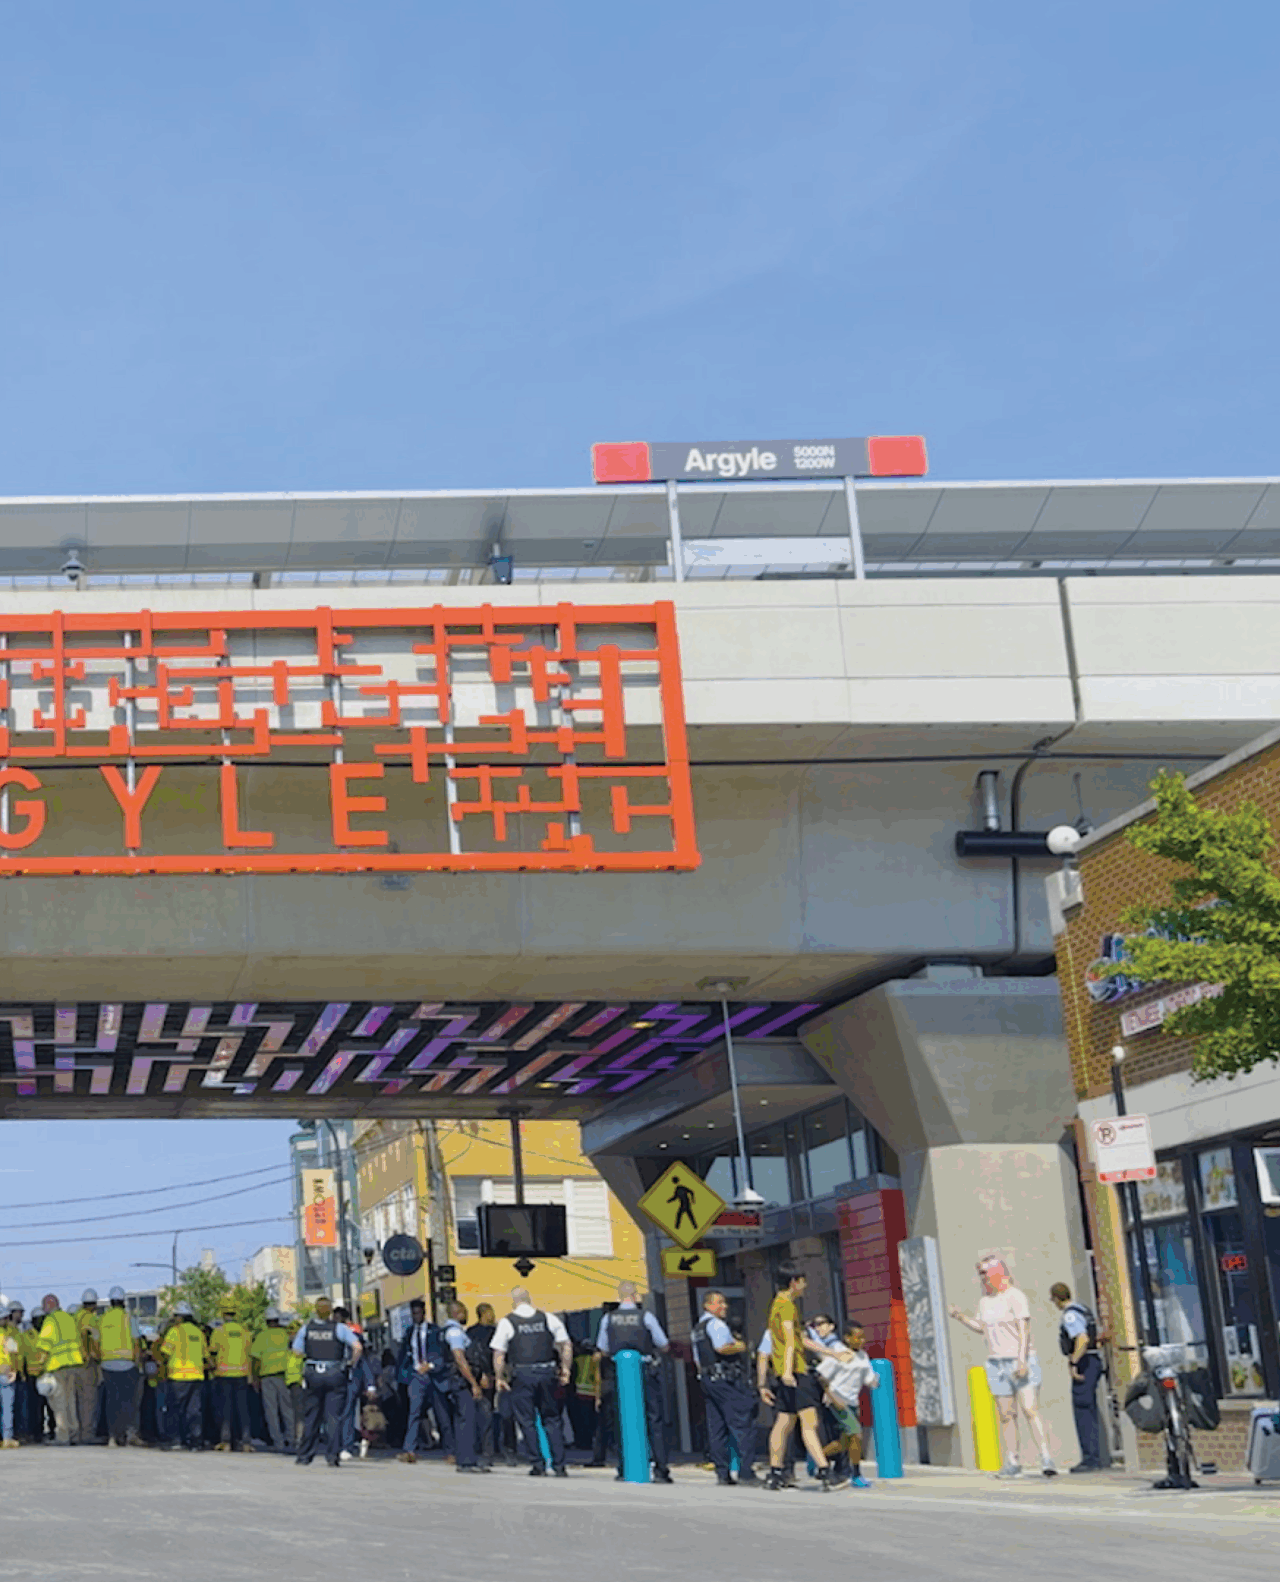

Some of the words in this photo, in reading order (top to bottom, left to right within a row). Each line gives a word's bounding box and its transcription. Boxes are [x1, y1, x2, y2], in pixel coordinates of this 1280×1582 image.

[793, 445, 835, 457] 5000N
[684, 447, 777, 477] Argyle
[794, 457, 835, 469] 1200W
[518, 1322, 545, 1334] POLICE
